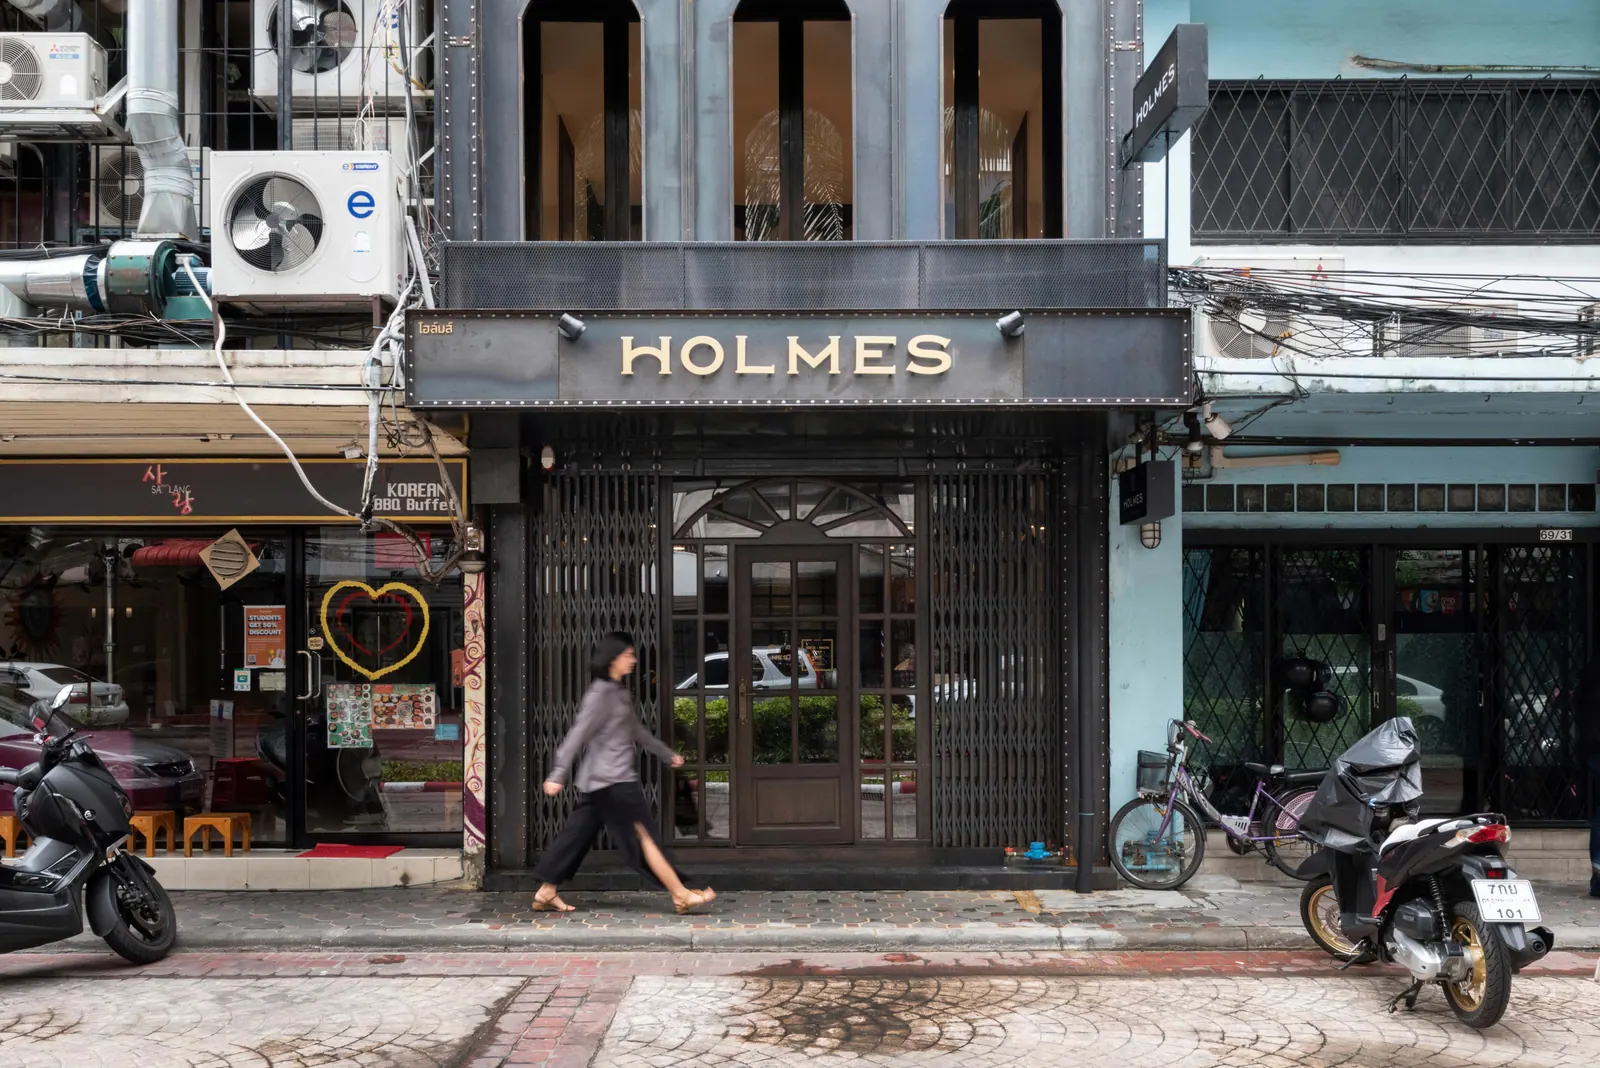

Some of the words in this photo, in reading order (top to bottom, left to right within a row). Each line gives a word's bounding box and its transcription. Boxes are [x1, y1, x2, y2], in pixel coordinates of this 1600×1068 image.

[1136, 63, 1175, 128] HOLMES
[347, 190, 375, 219] e
[418, 321, 453, 334] โฮล์มส์
[620, 334, 952, 376] HOLMES
[387, 482, 447, 497] KOREAN
[373, 498, 401, 511] BBQ
[406, 498, 456, 511] Buffet
[1123, 492, 1143, 509] HOLMES
[1540, 530, 1572, 540] 69/31
[1497, 908, 1523, 919] 101
